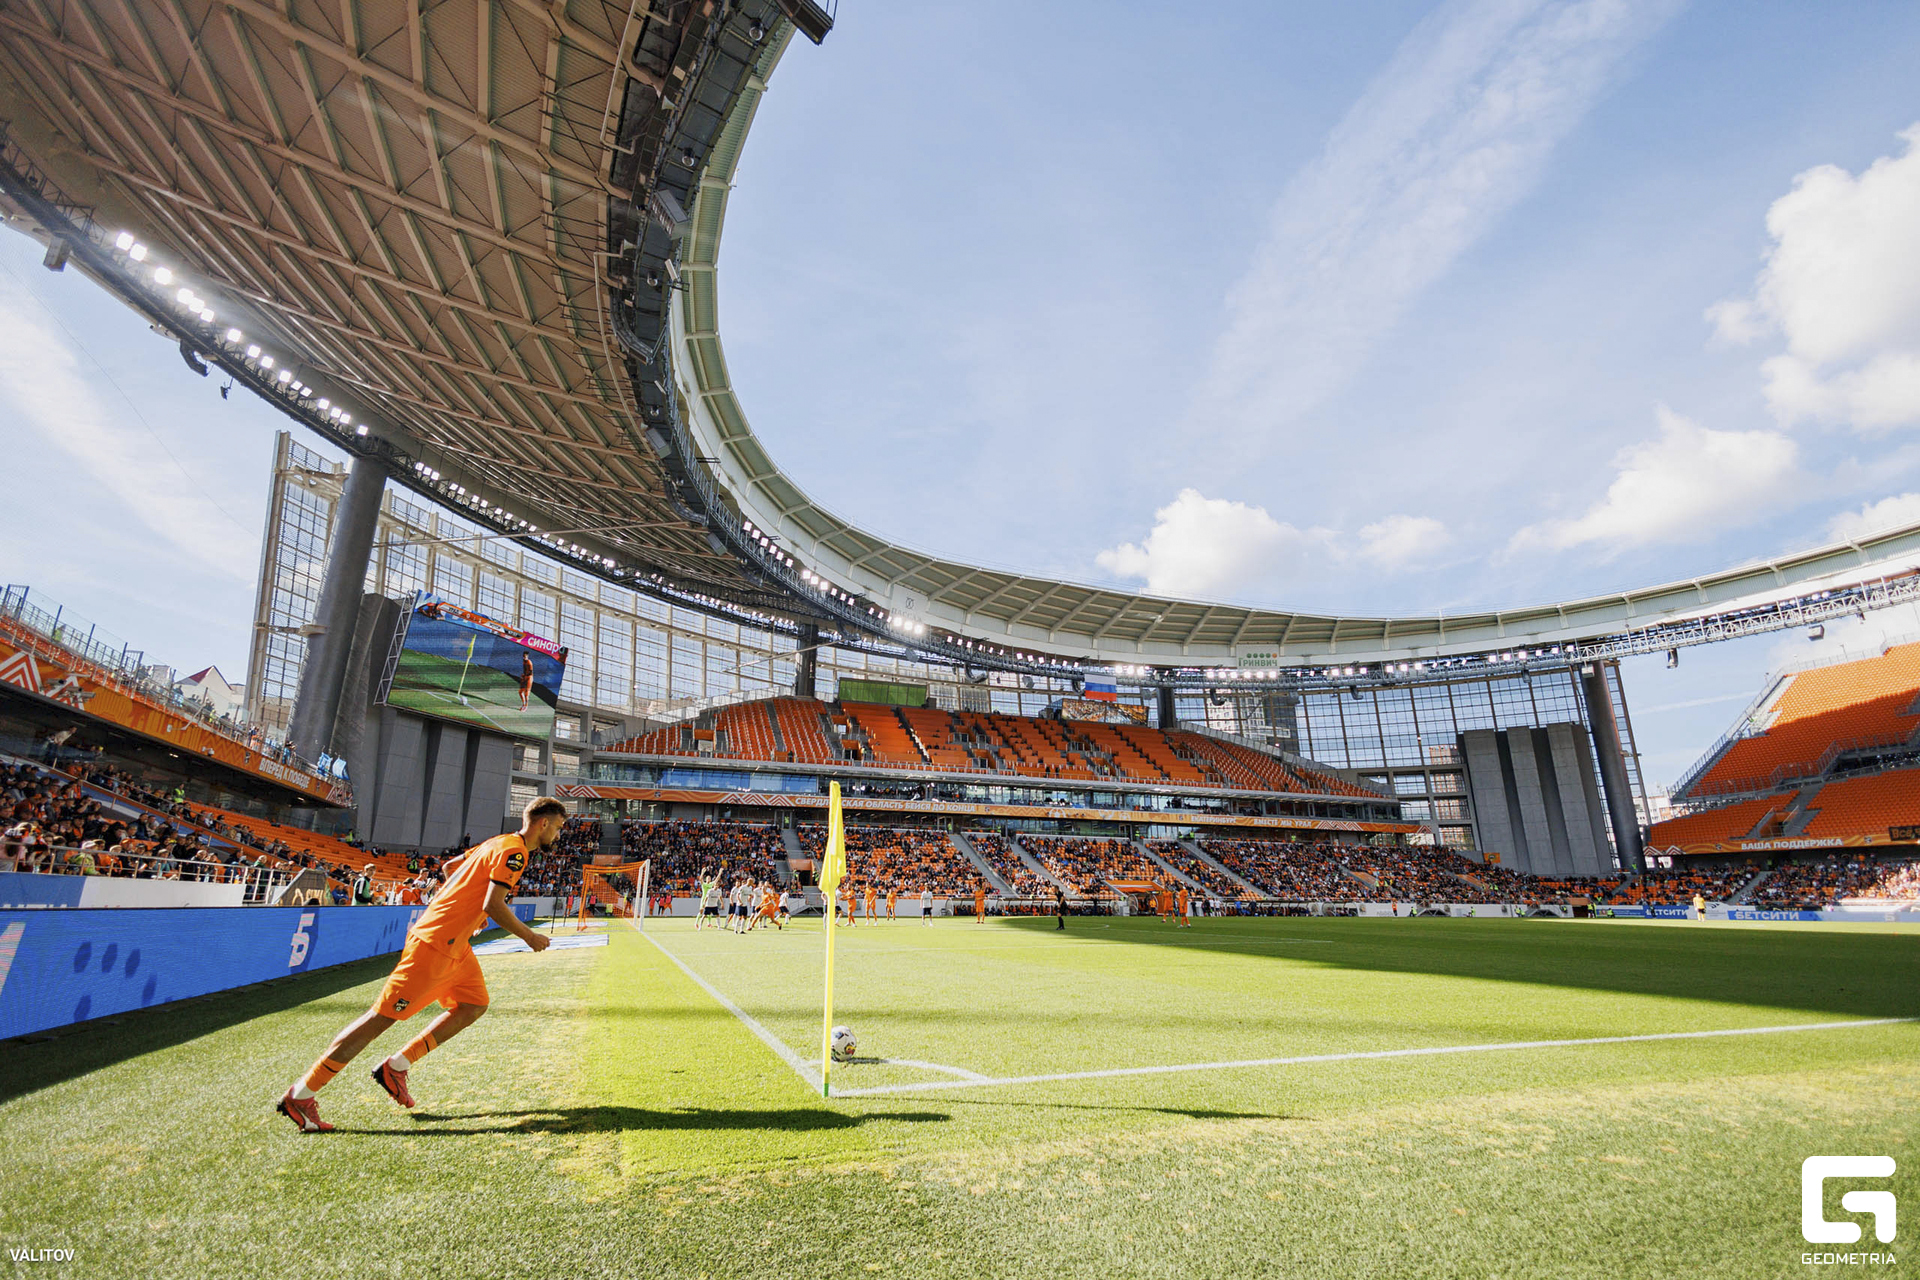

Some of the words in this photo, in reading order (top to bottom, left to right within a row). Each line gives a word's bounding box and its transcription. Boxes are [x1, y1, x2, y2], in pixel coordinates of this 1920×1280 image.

[1238, 657, 1278, 667] ГРИНВИЧ
[795, 797, 864, 807] СВЕРДЛСКАЯ
[865, 800, 904, 809] ОБЛАСТЬ
[932, 803, 945, 811] ДО
[946, 804, 976, 812] КОНЦА
[1741, 842, 1771, 850] ВАША
[1773, 838, 1843, 849] ПОДДЕРЖКА
[1735, 911, 1800, 920] БЕТСИТИ
